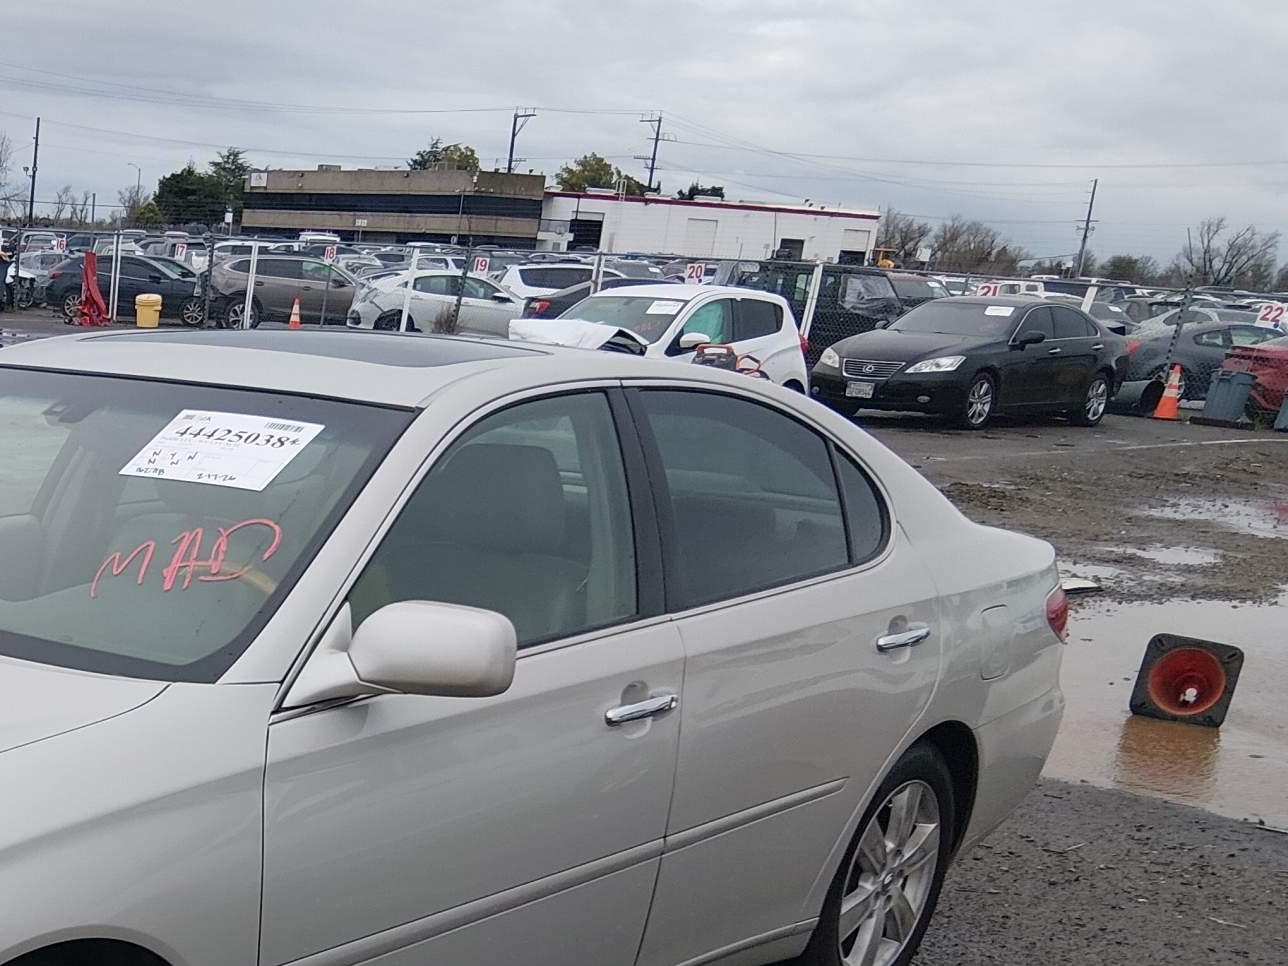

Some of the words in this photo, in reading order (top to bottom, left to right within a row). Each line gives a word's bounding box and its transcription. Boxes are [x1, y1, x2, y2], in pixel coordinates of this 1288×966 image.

[56, 239, 65, 250] 16
[176, 245, 186, 257] 17
[325, 246, 335, 260] 18
[475, 259, 488, 272] 19
[687, 265, 703, 279] 20
[980, 285, 998, 296] 21
[1259, 304, 1284, 323] 22
